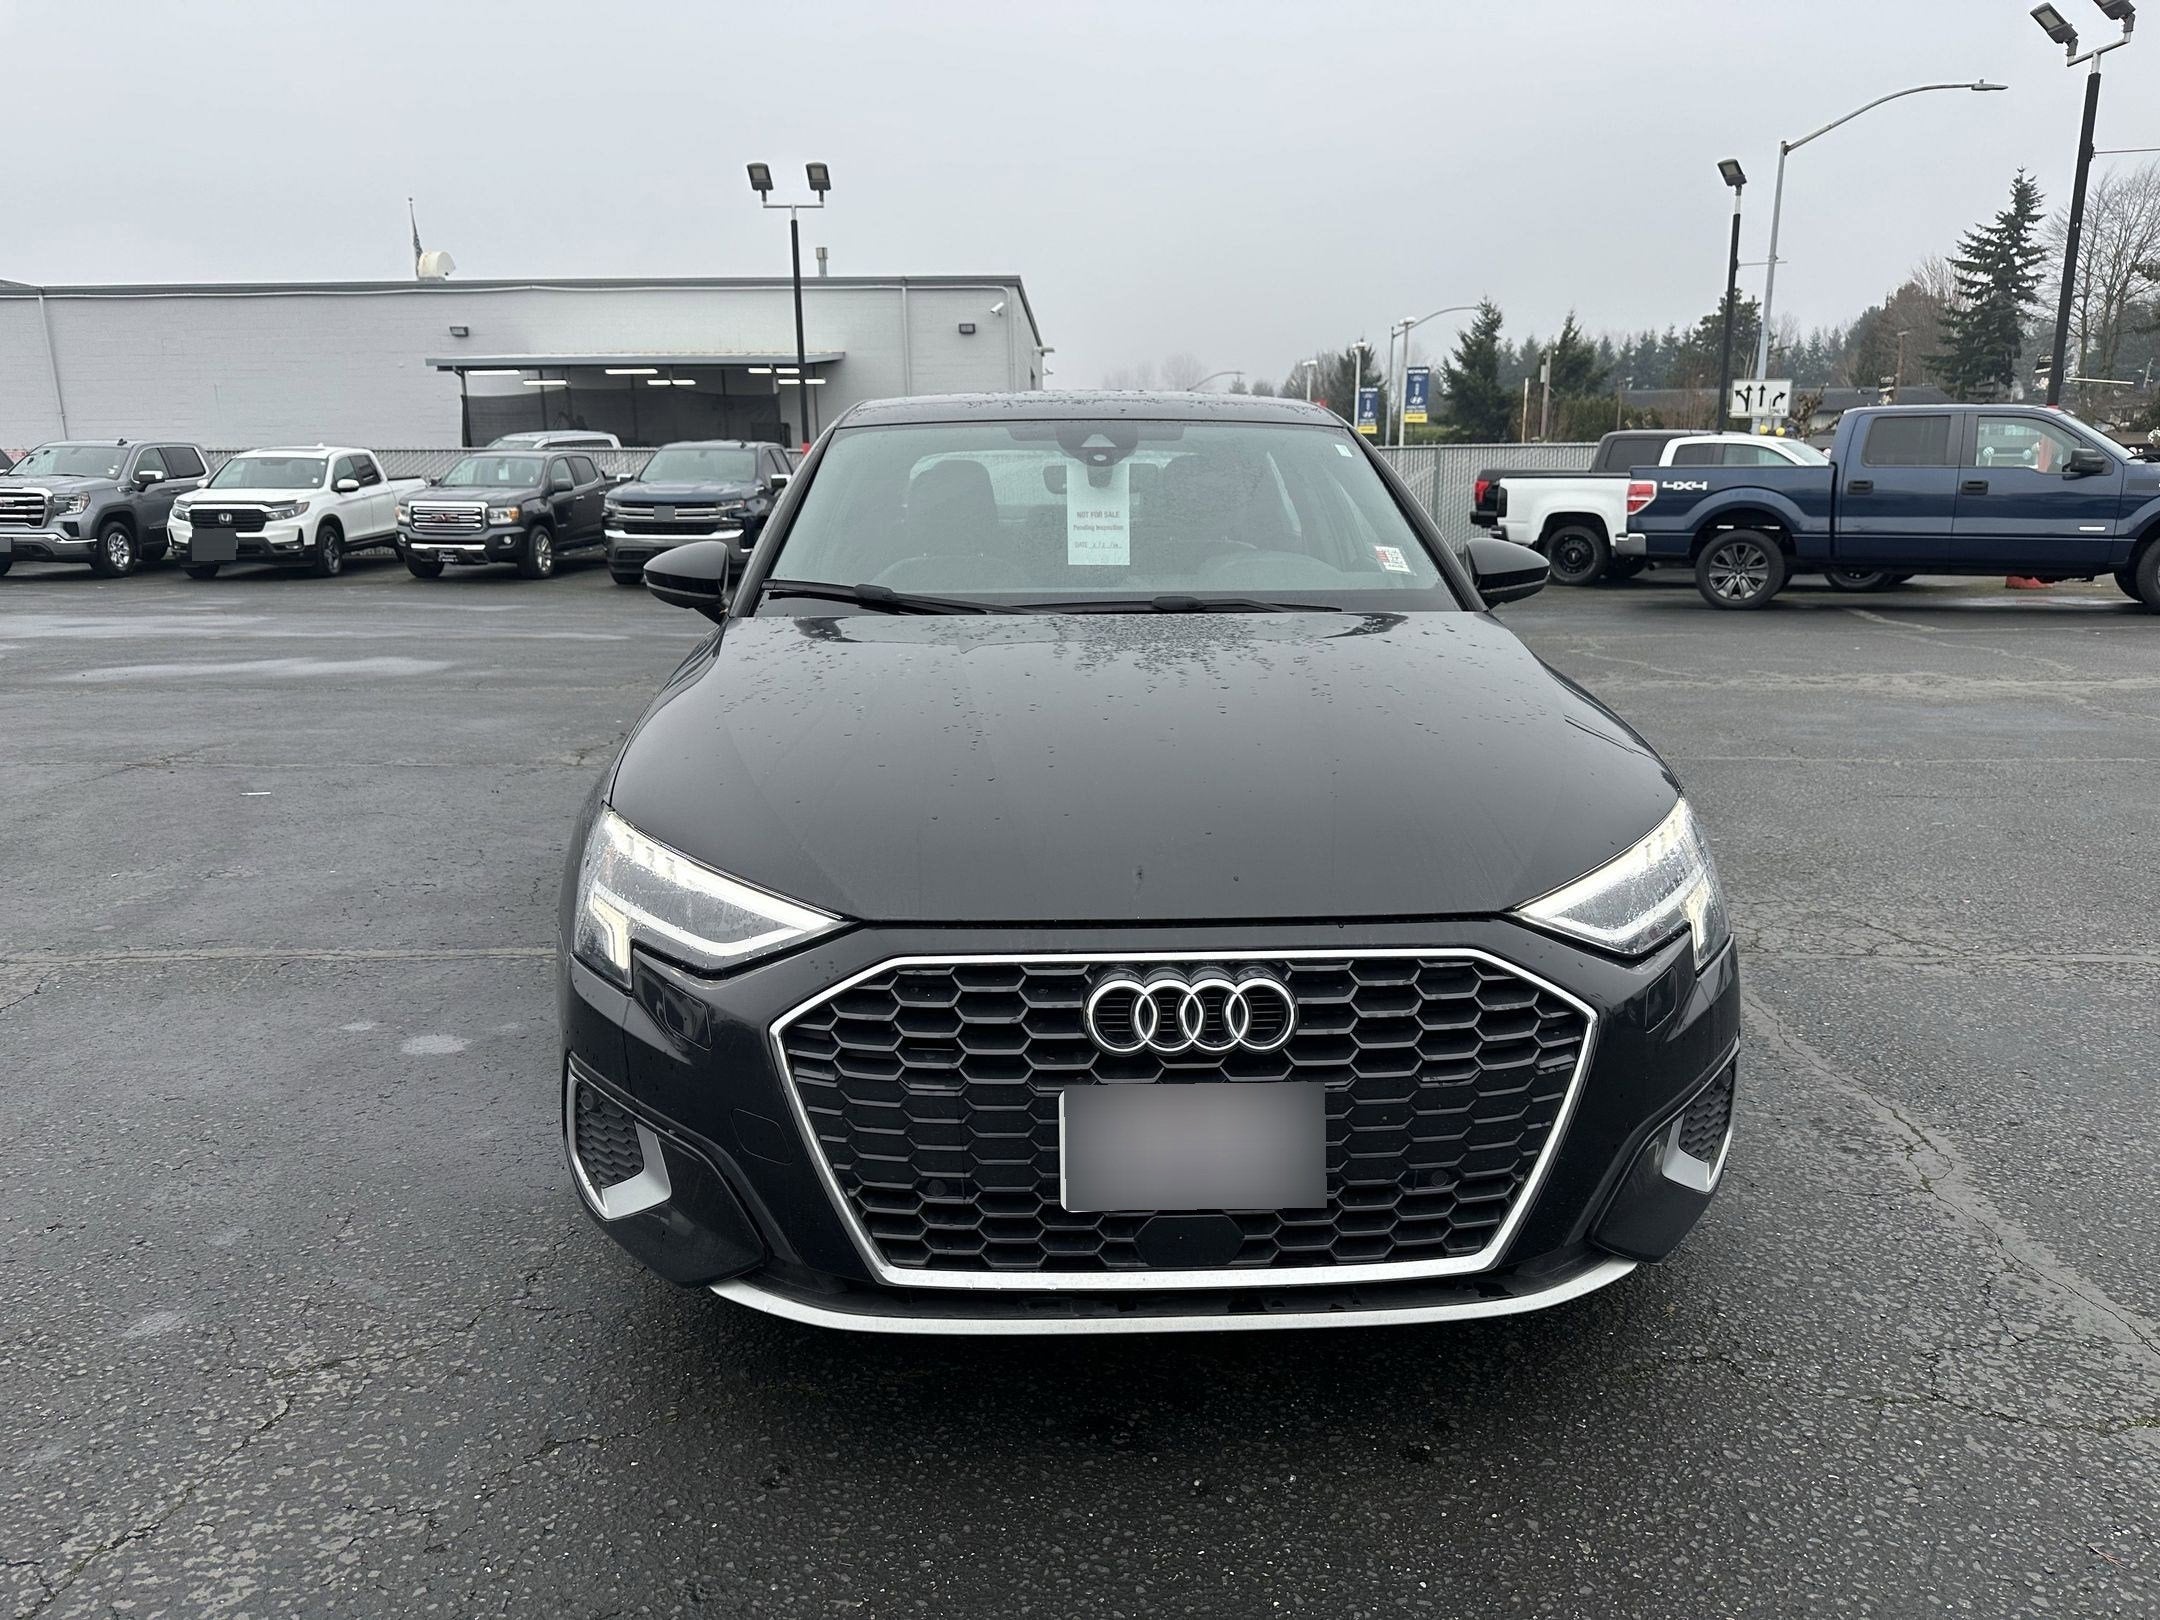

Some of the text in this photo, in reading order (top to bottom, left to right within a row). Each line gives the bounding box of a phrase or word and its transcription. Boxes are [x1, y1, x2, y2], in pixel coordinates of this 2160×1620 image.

[1076, 511, 1121, 519] NOT FOR SALE
